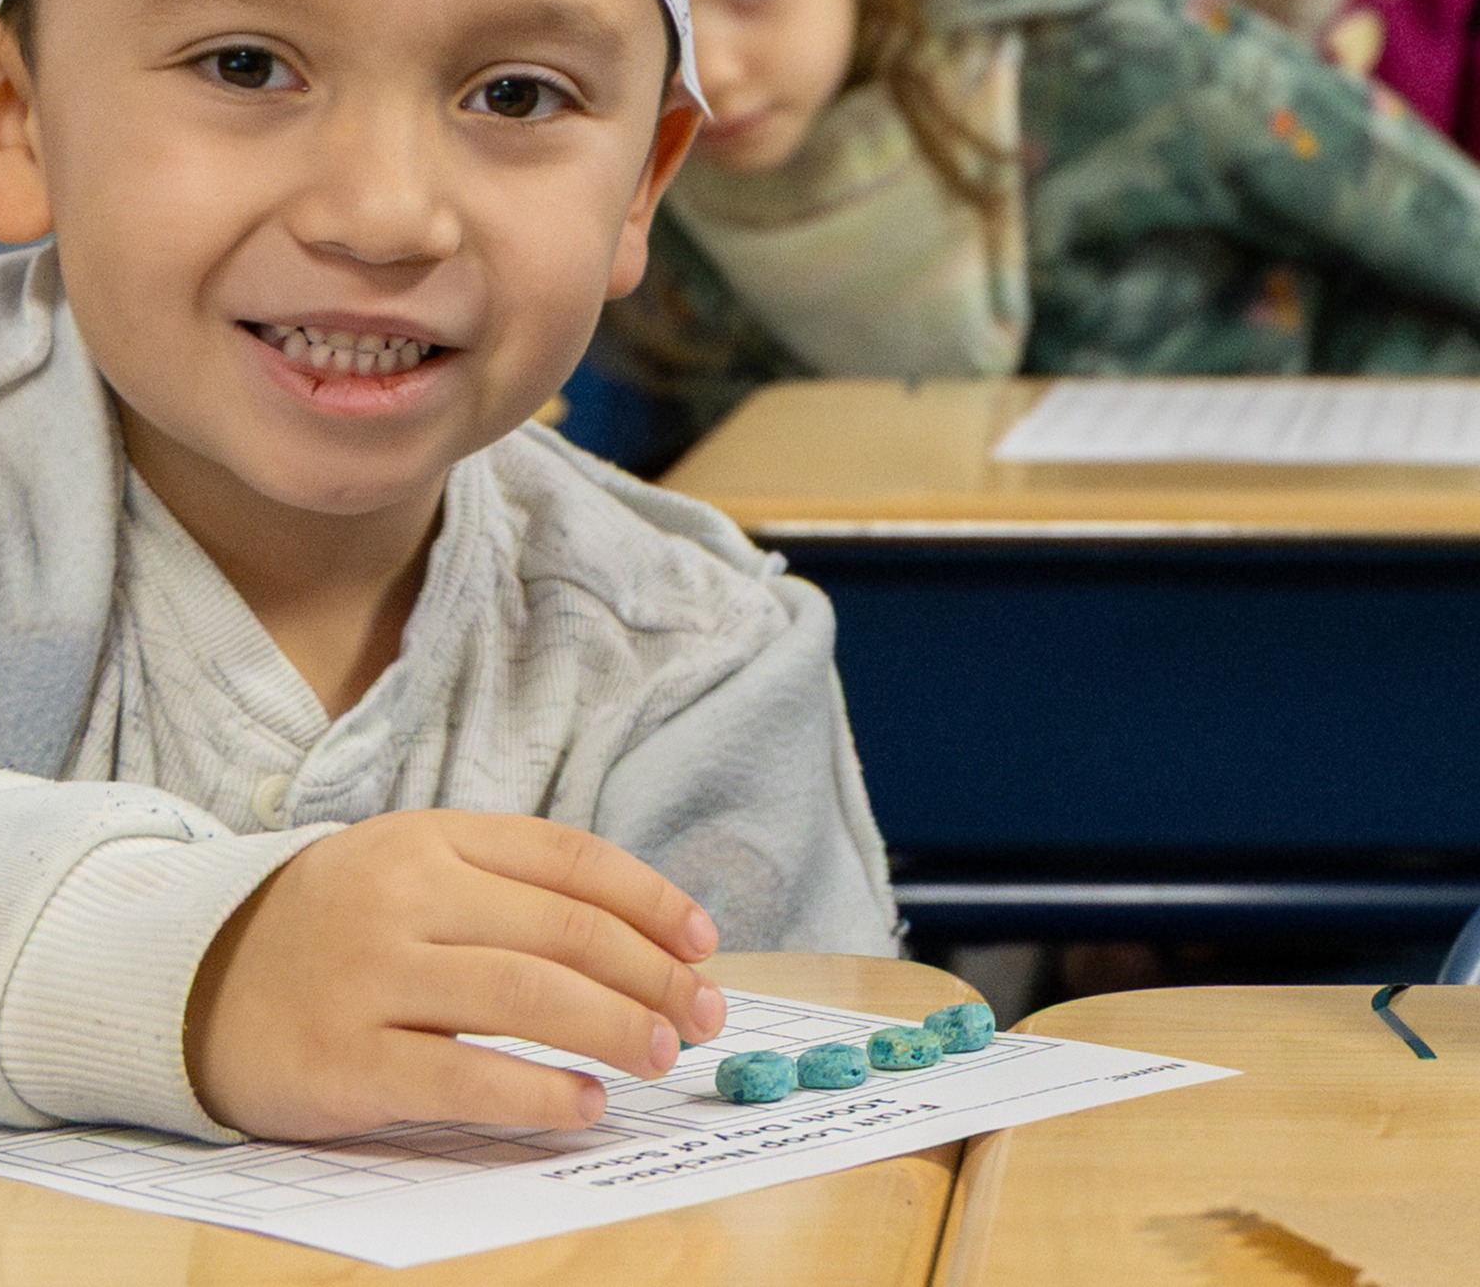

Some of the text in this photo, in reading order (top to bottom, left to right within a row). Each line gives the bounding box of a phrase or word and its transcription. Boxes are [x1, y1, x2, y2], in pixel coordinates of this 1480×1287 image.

[1103, 1061, 1188, 1083] Name:
[540, 1097, 898, 1182] 100th Day of School
[589, 1102, 943, 1188] Fruit Loop Necklace
